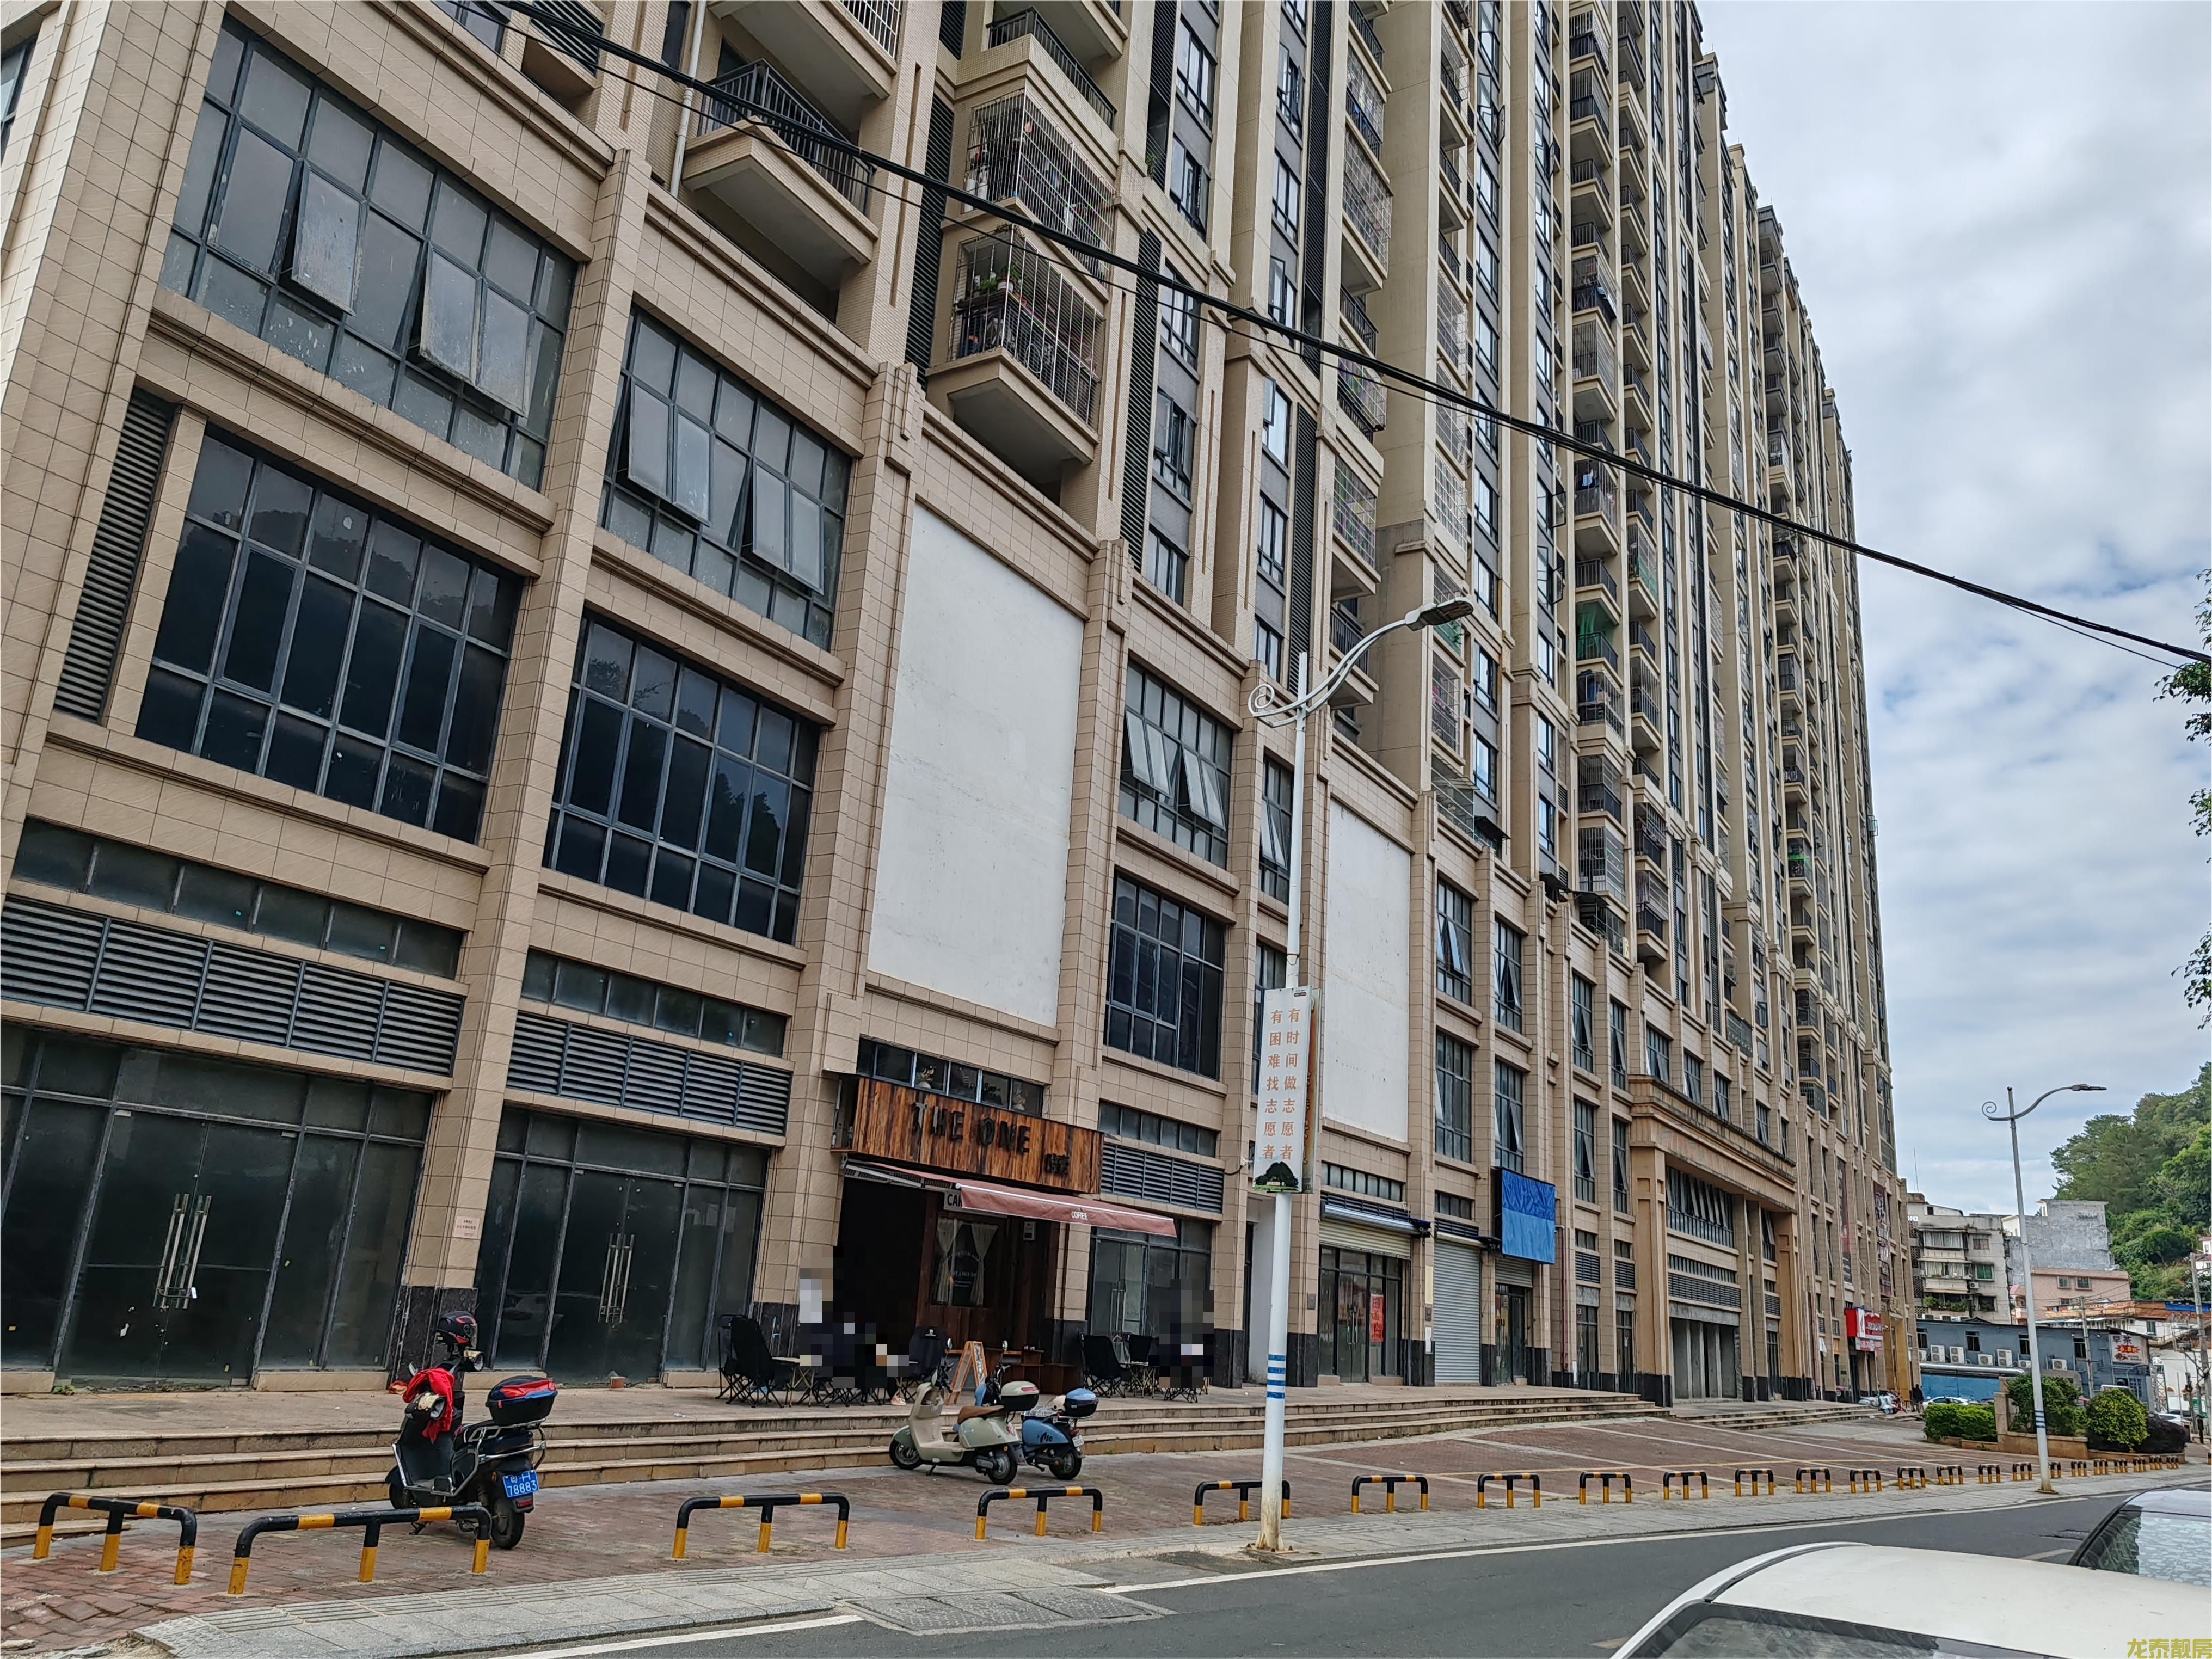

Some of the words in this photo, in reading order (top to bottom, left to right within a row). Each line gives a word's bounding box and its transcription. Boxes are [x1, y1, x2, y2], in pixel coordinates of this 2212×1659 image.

[1262, 1010, 1283, 1160] 有困难找志愿者
[1280, 1007, 1301, 1160] 有时间做志愿者
[912, 1102, 965, 1142] THE
[979, 1118, 1031, 1155] ONE
[2112, 1335, 2132, 1344] 早茶
[507, 1480, 537, 1497] 78883
